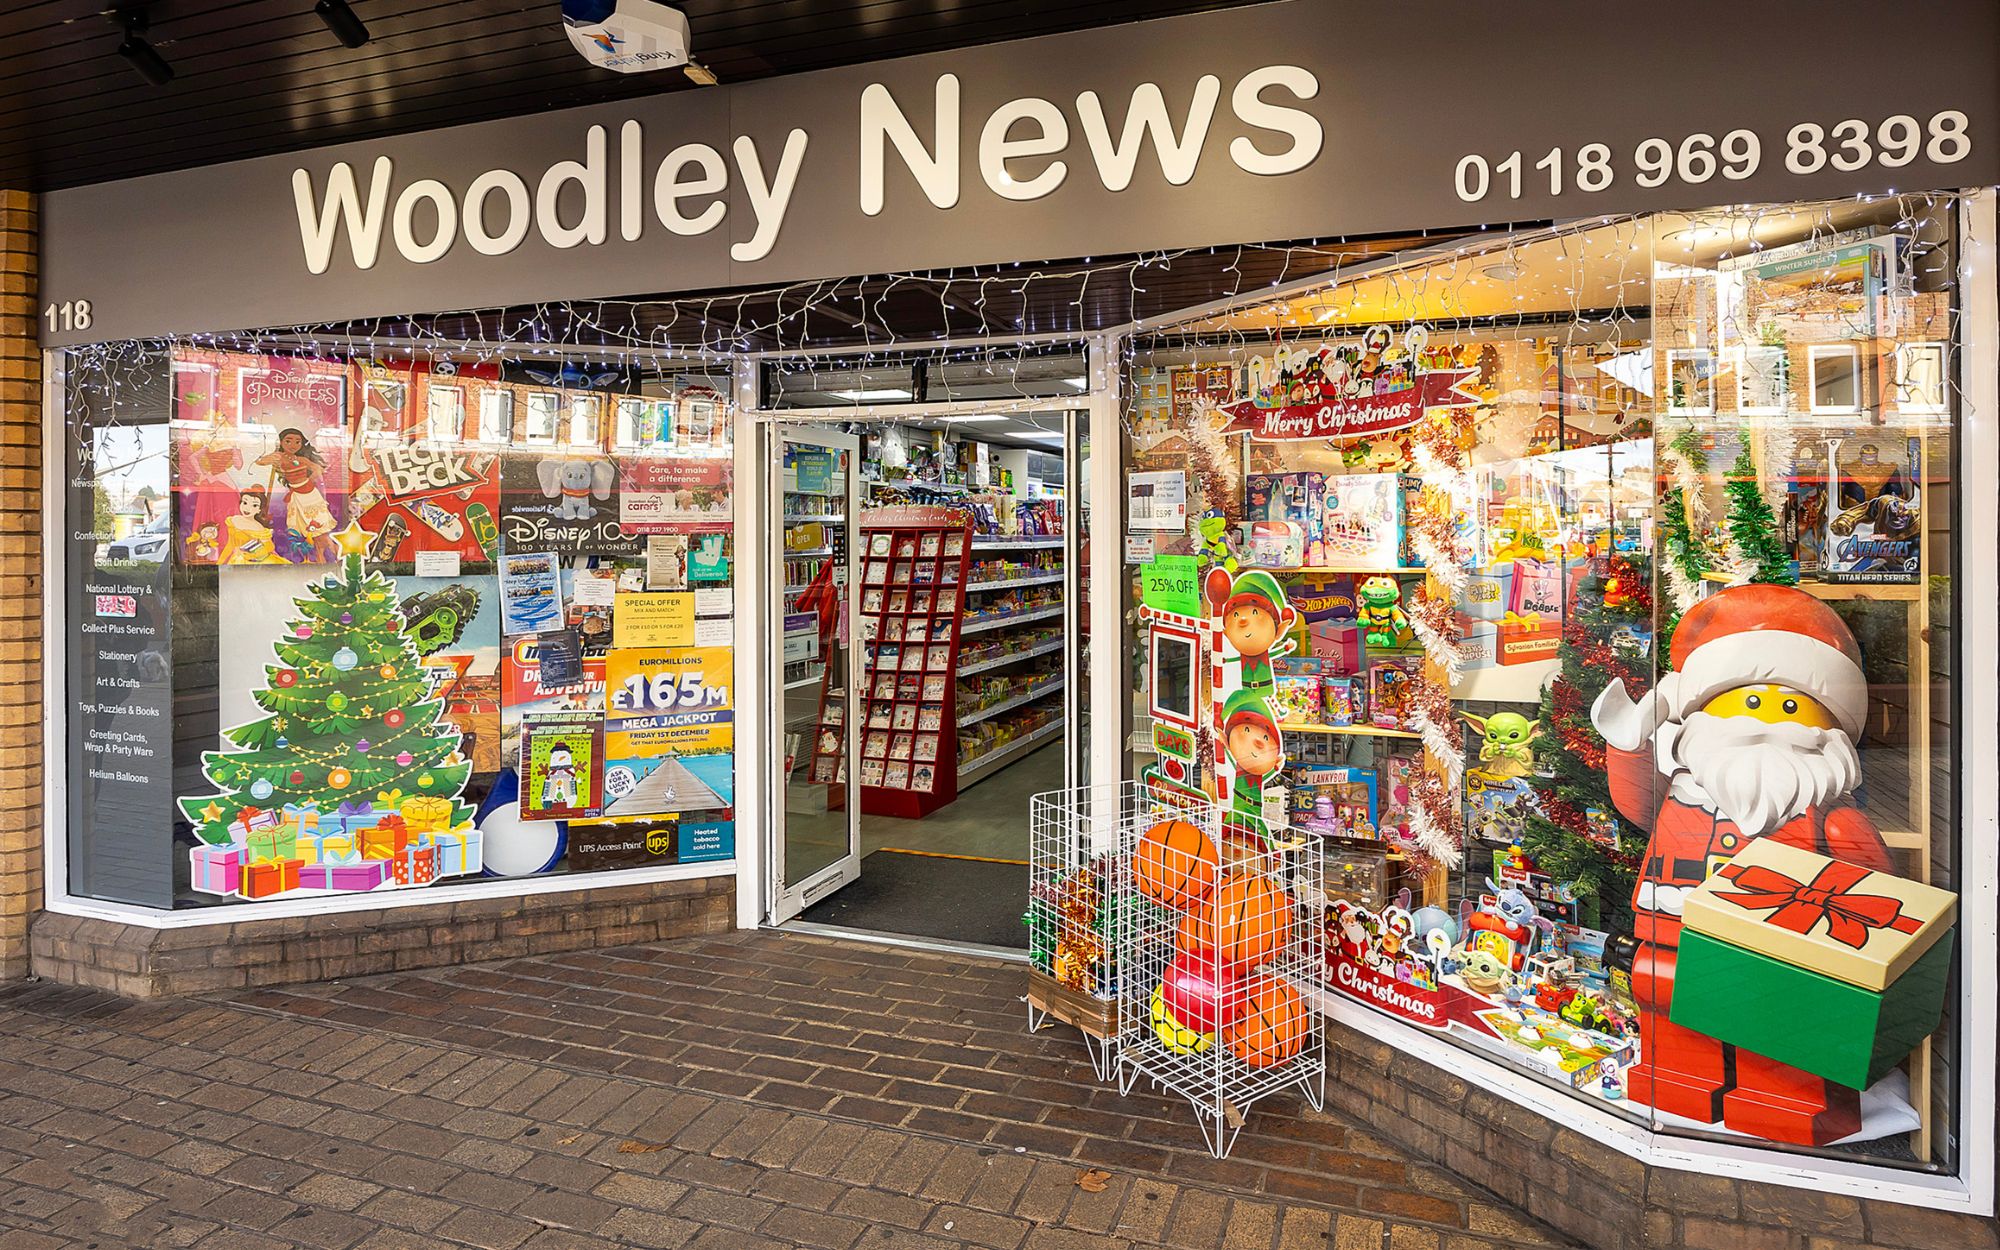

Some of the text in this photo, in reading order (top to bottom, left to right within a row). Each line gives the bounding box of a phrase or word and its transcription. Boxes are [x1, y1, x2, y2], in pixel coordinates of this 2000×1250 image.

[1454, 110, 1972, 202] 0118 969 8398
[292, 64, 1324, 275] Woodley News
[1775, 255, 1832, 273] WINTER SUNSET
[45, 300, 93, 332] 118
[1183, 361, 1218, 370] SORE
[1260, 401, 1411, 436] Merry Christmas
[373, 441, 454, 475] TECH
[388, 456, 473, 496] DECK
[649, 465, 709, 475] Care, to make
[658, 475, 701, 483] difference
[628, 503, 659, 511] carers
[502, 514, 591, 551] Disney
[516, 543, 533, 551] 100
[597, 543, 638, 551] WONDER
[1837, 534, 1912, 562] AVENGERS
[114, 558, 138, 568] Drinks
[1838, 573, 1911, 582] TITAN HERO SERIES
[85, 583, 152, 596] National Lottery &
[1150, 578, 1194, 594] 25% OFF
[624, 598, 681, 607] SPECIAL OFFER
[1305, 596, 1351, 611] HOT WHEELS
[81, 622, 156, 635] Collect Plus Service
[1507, 640, 1557, 652] Sylvanian Families
[98, 650, 138, 663] Stationery
[639, 656, 703, 666] EUROMILLIONS
[96, 676, 141, 688] Art & Crafts
[611, 670, 728, 710] £165M
[78, 702, 160, 717] Toys, Puzzles & Books
[622, 712, 717, 730] MEGA JACKPOT
[89, 728, 148, 744] Greeting Cards,
[630, 729, 709, 739] FRIDAY 1ST DECEMBER
[84, 741, 154, 757] Wrap & Party Ware
[1157, 729, 1191, 755] DAYS
[89, 768, 149, 784] Helium Balloons
[609, 776, 622, 784] FOR
[610, 769, 624, 778] ASK
[1312, 771, 1347, 784] LANKYBOX
[609, 779, 631, 790] LUCKY
[1296, 795, 1314, 810] IG
[693, 827, 718, 835] Heated
[579, 843, 596, 853] UPS
[596, 841, 622, 852] Access
[648, 836, 667, 851] ups
[1337, 962, 1436, 1020] Christmas
